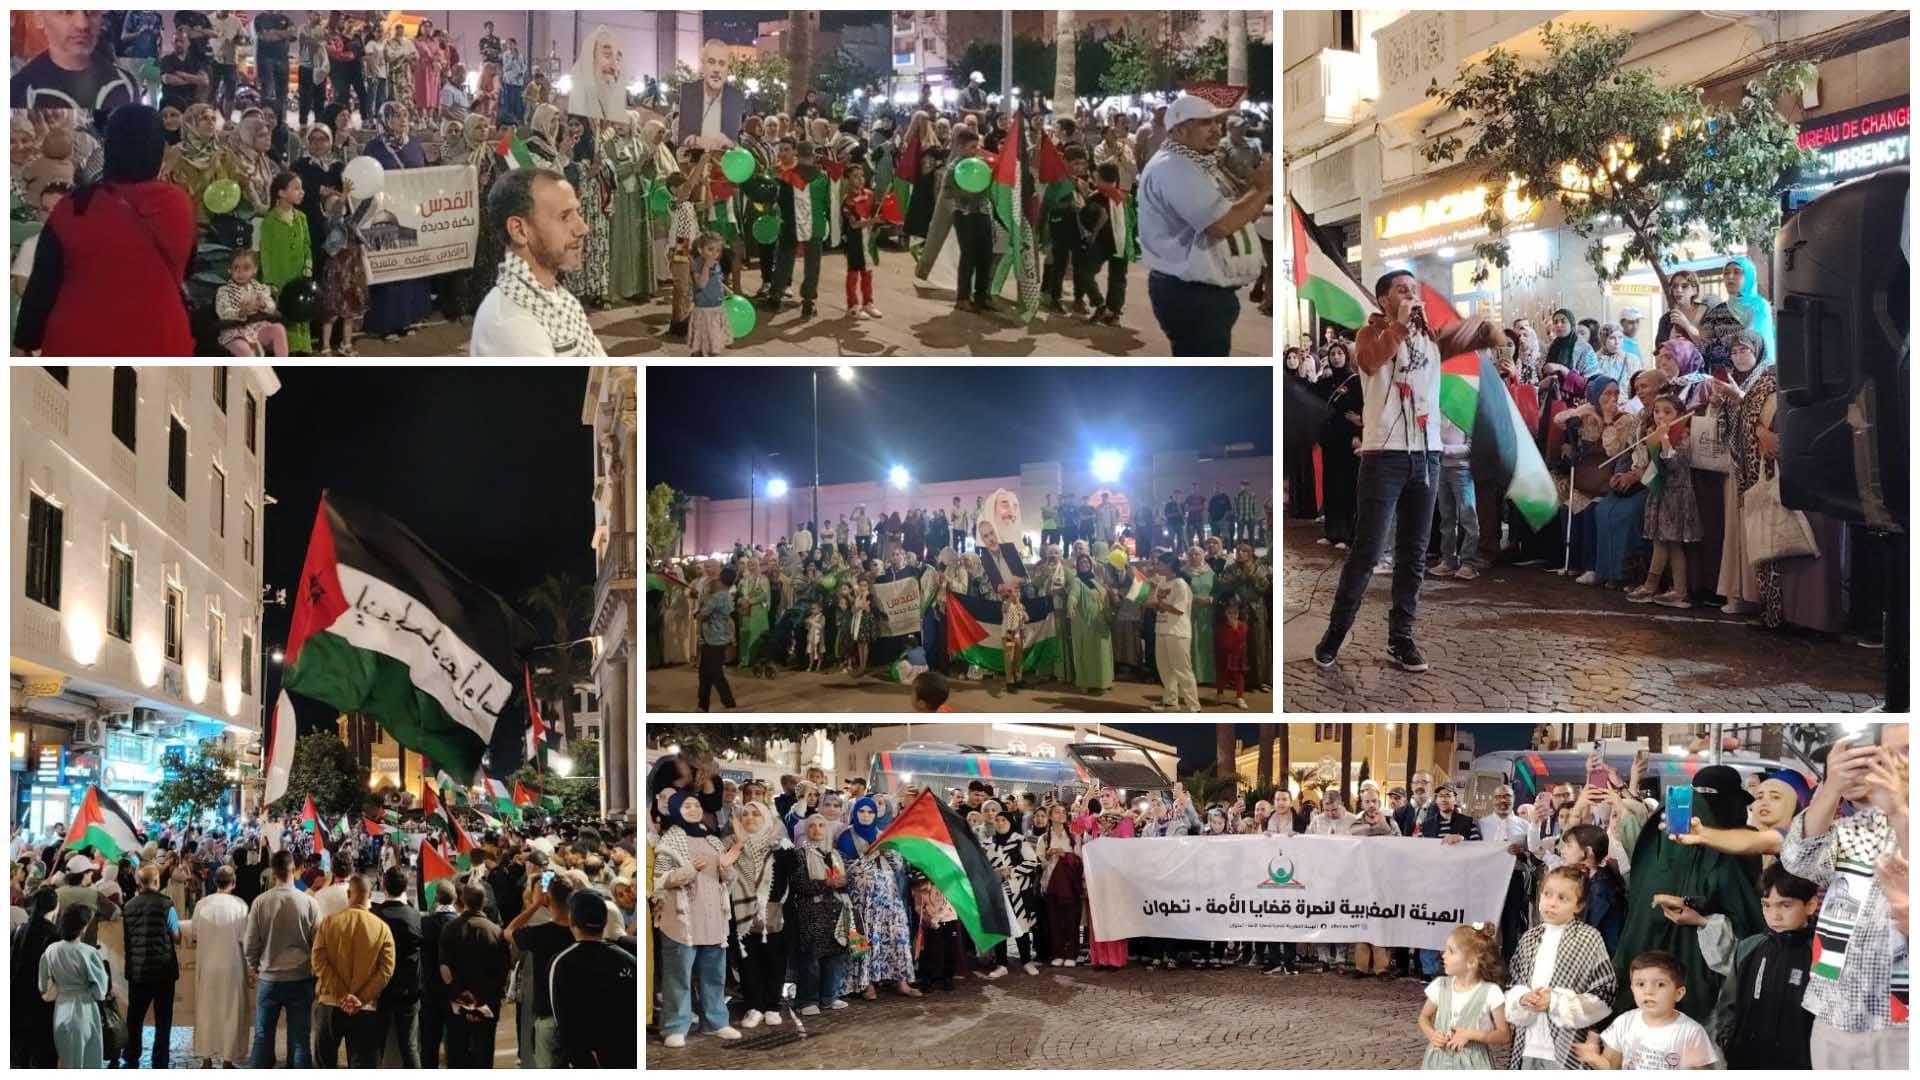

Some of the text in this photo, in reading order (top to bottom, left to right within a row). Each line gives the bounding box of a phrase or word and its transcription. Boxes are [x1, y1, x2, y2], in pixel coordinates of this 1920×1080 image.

[1842, 119, 1860, 140] DE
[420, 191, 473, 218] القدس
[420, 221, 450, 234] جديدة
[1143, 898, 1190, 917] تطوان
[1206, 893, 1246, 915] الأمة
[1249, 899, 1292, 918] قضايا
[1296, 899, 1336, 918] لنصرة
[1340, 899, 1405, 920] المغربية
[1410, 903, 1464, 926] الهيئة
